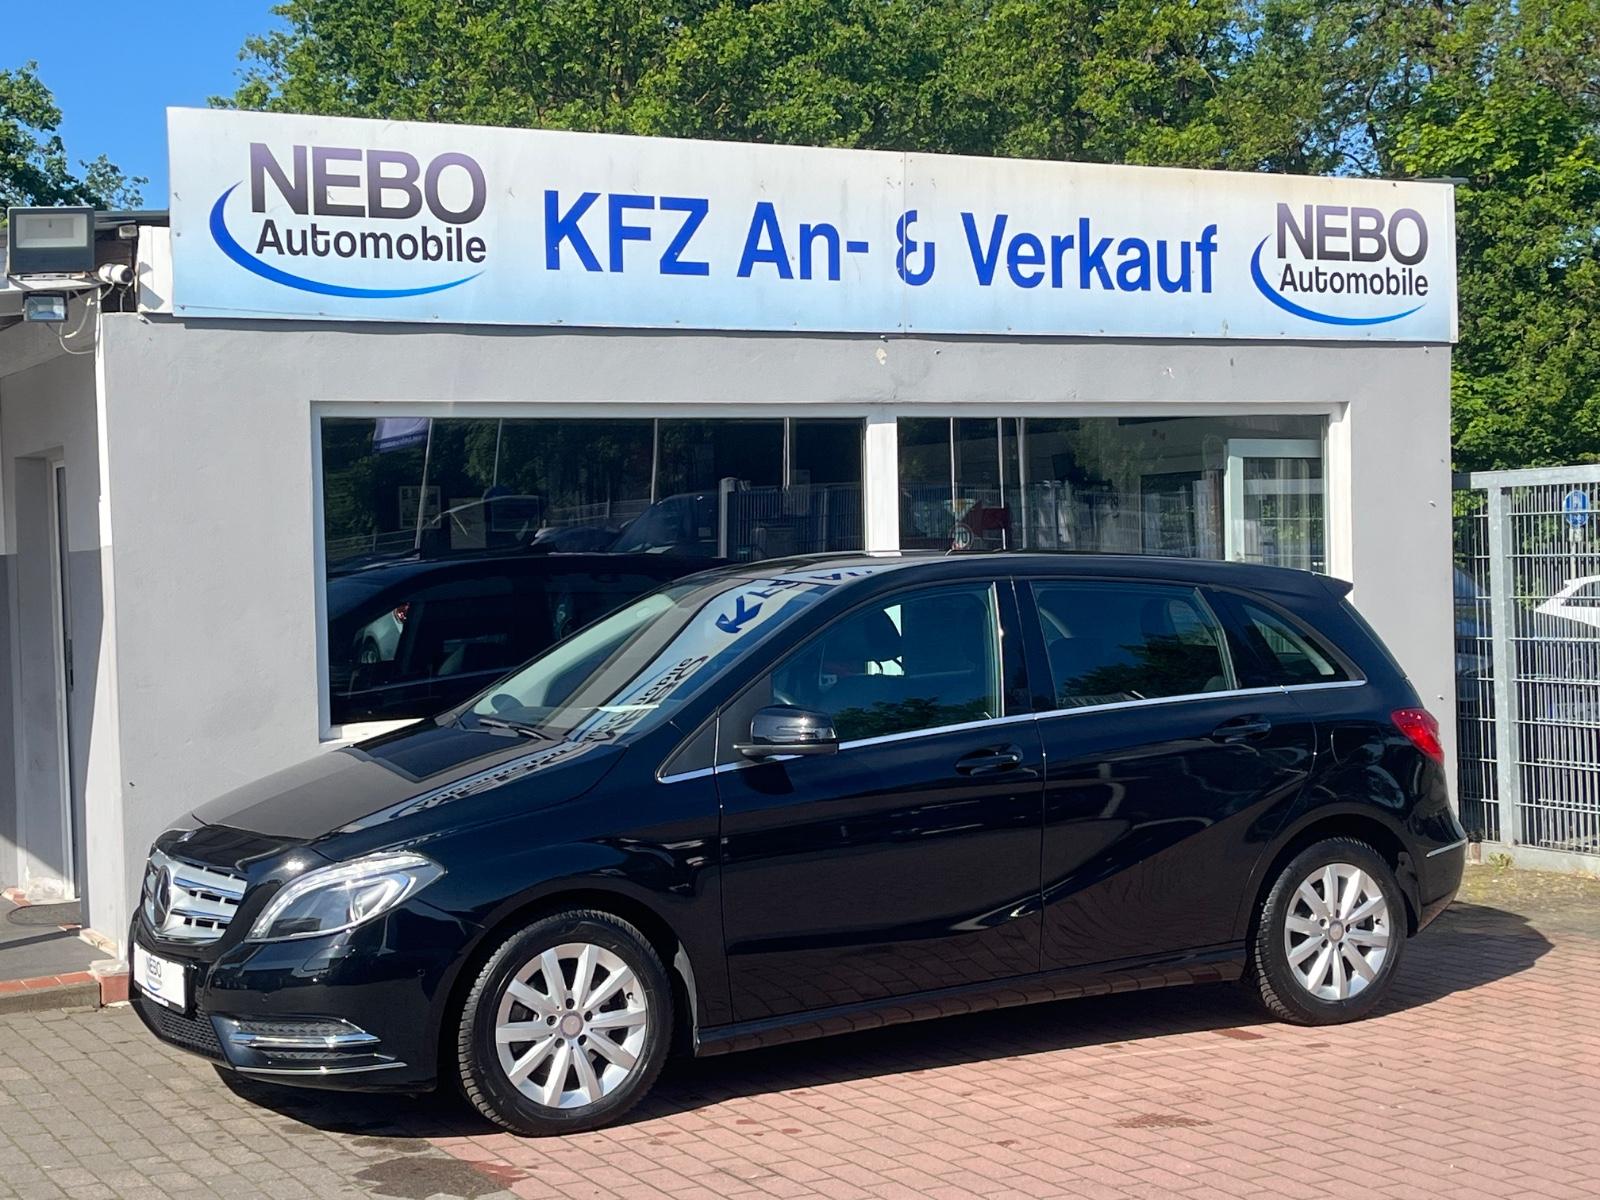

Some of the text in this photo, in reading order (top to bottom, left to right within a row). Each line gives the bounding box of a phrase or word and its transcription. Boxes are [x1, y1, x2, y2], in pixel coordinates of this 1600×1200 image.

[250, 143, 487, 225] NEBO
[256, 219, 487, 263] Automobile
[544, 190, 1218, 293] KFZ An- & Verkauf
[1277, 203, 1428, 265] NEBO
[1279, 264, 1429, 296] Automobile
